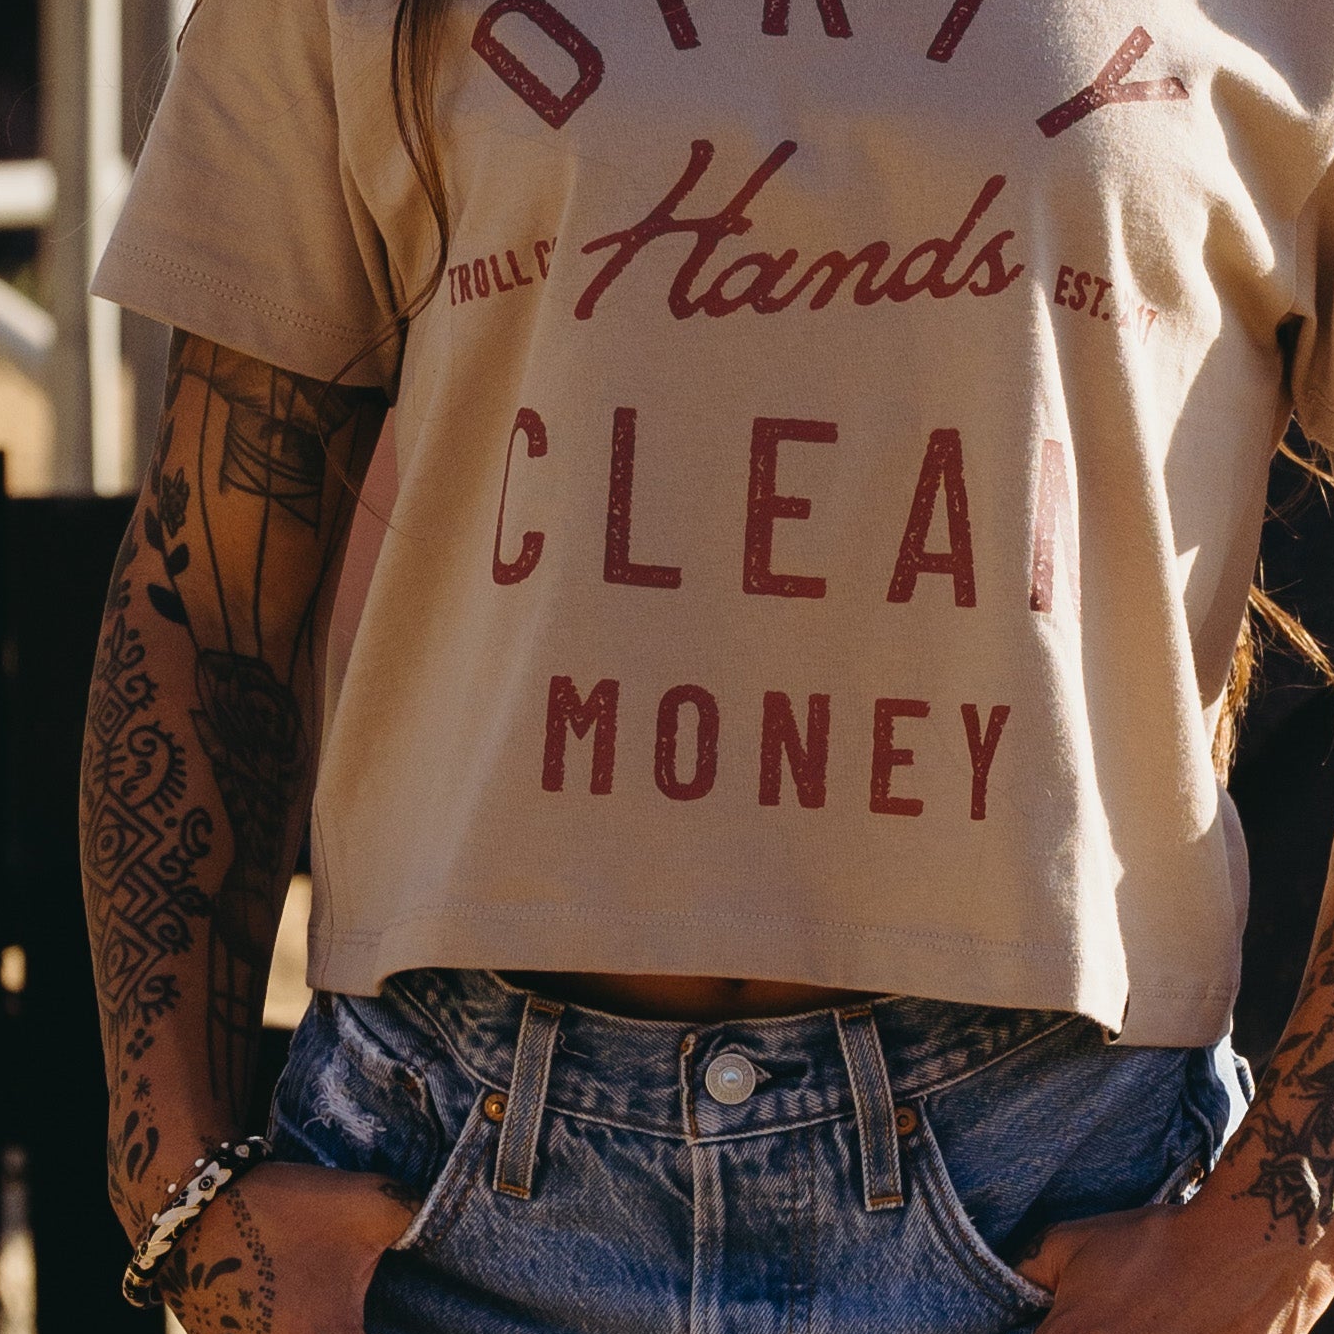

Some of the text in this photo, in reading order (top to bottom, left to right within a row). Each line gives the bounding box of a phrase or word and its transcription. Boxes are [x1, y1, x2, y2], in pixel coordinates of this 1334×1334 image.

[448, 237, 558, 306] TROLL C
[574, 140, 1025, 320] Hands
[1054, 265, 1113, 321] EST.
[542, 676, 1010, 820] MONEY
